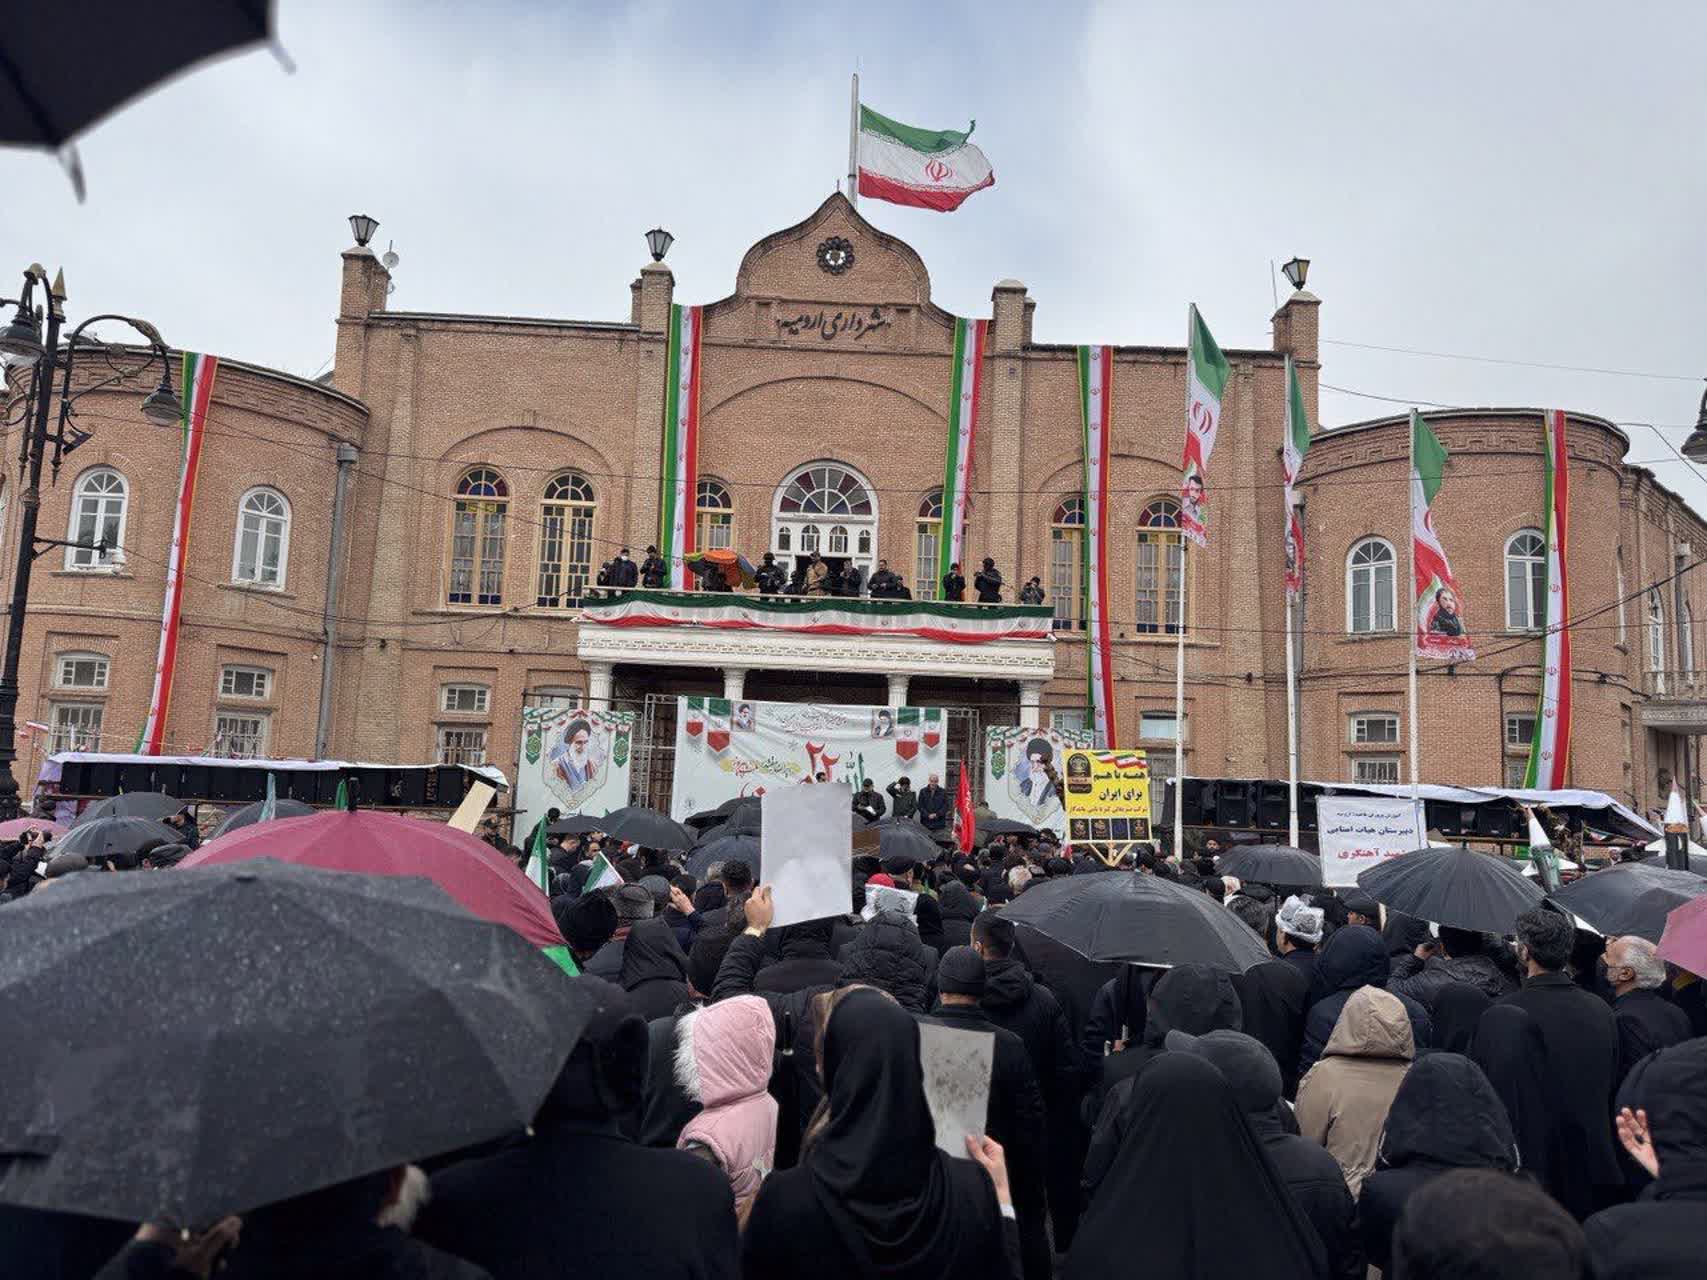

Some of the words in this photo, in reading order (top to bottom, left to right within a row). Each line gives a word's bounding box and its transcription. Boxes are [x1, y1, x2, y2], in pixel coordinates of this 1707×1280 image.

[780, 309, 824, 335] ارومیه
[822, 305, 885, 341] شهرداری
[1099, 787, 1121, 801] ایران
[1123, 787, 1143, 801] برای
[1377, 826, 1414, 835] دبیرستان
